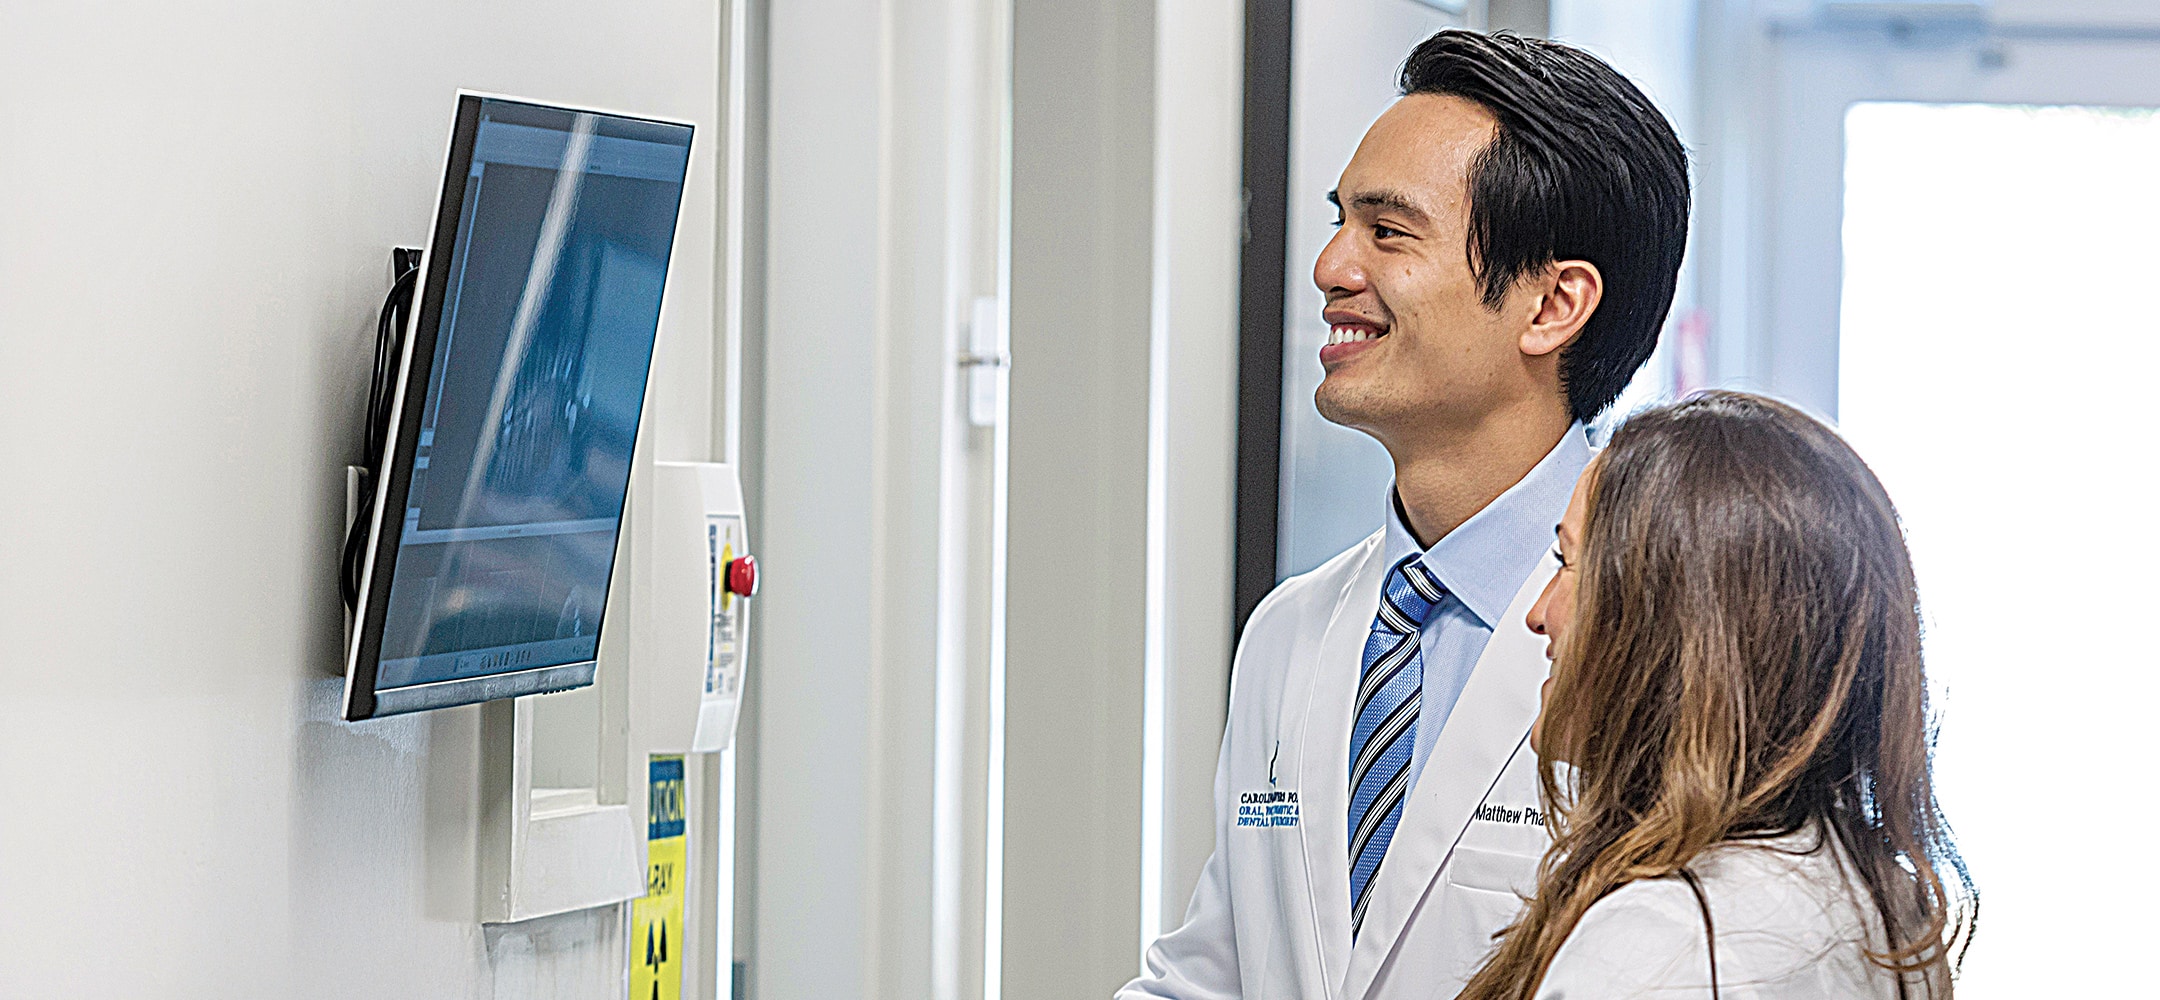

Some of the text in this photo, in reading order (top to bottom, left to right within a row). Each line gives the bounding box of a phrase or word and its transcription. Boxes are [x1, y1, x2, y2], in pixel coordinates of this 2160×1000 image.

[1237, 817, 1269, 827] DENTAL
[1475, 803, 1545, 826] Matthew Pha
